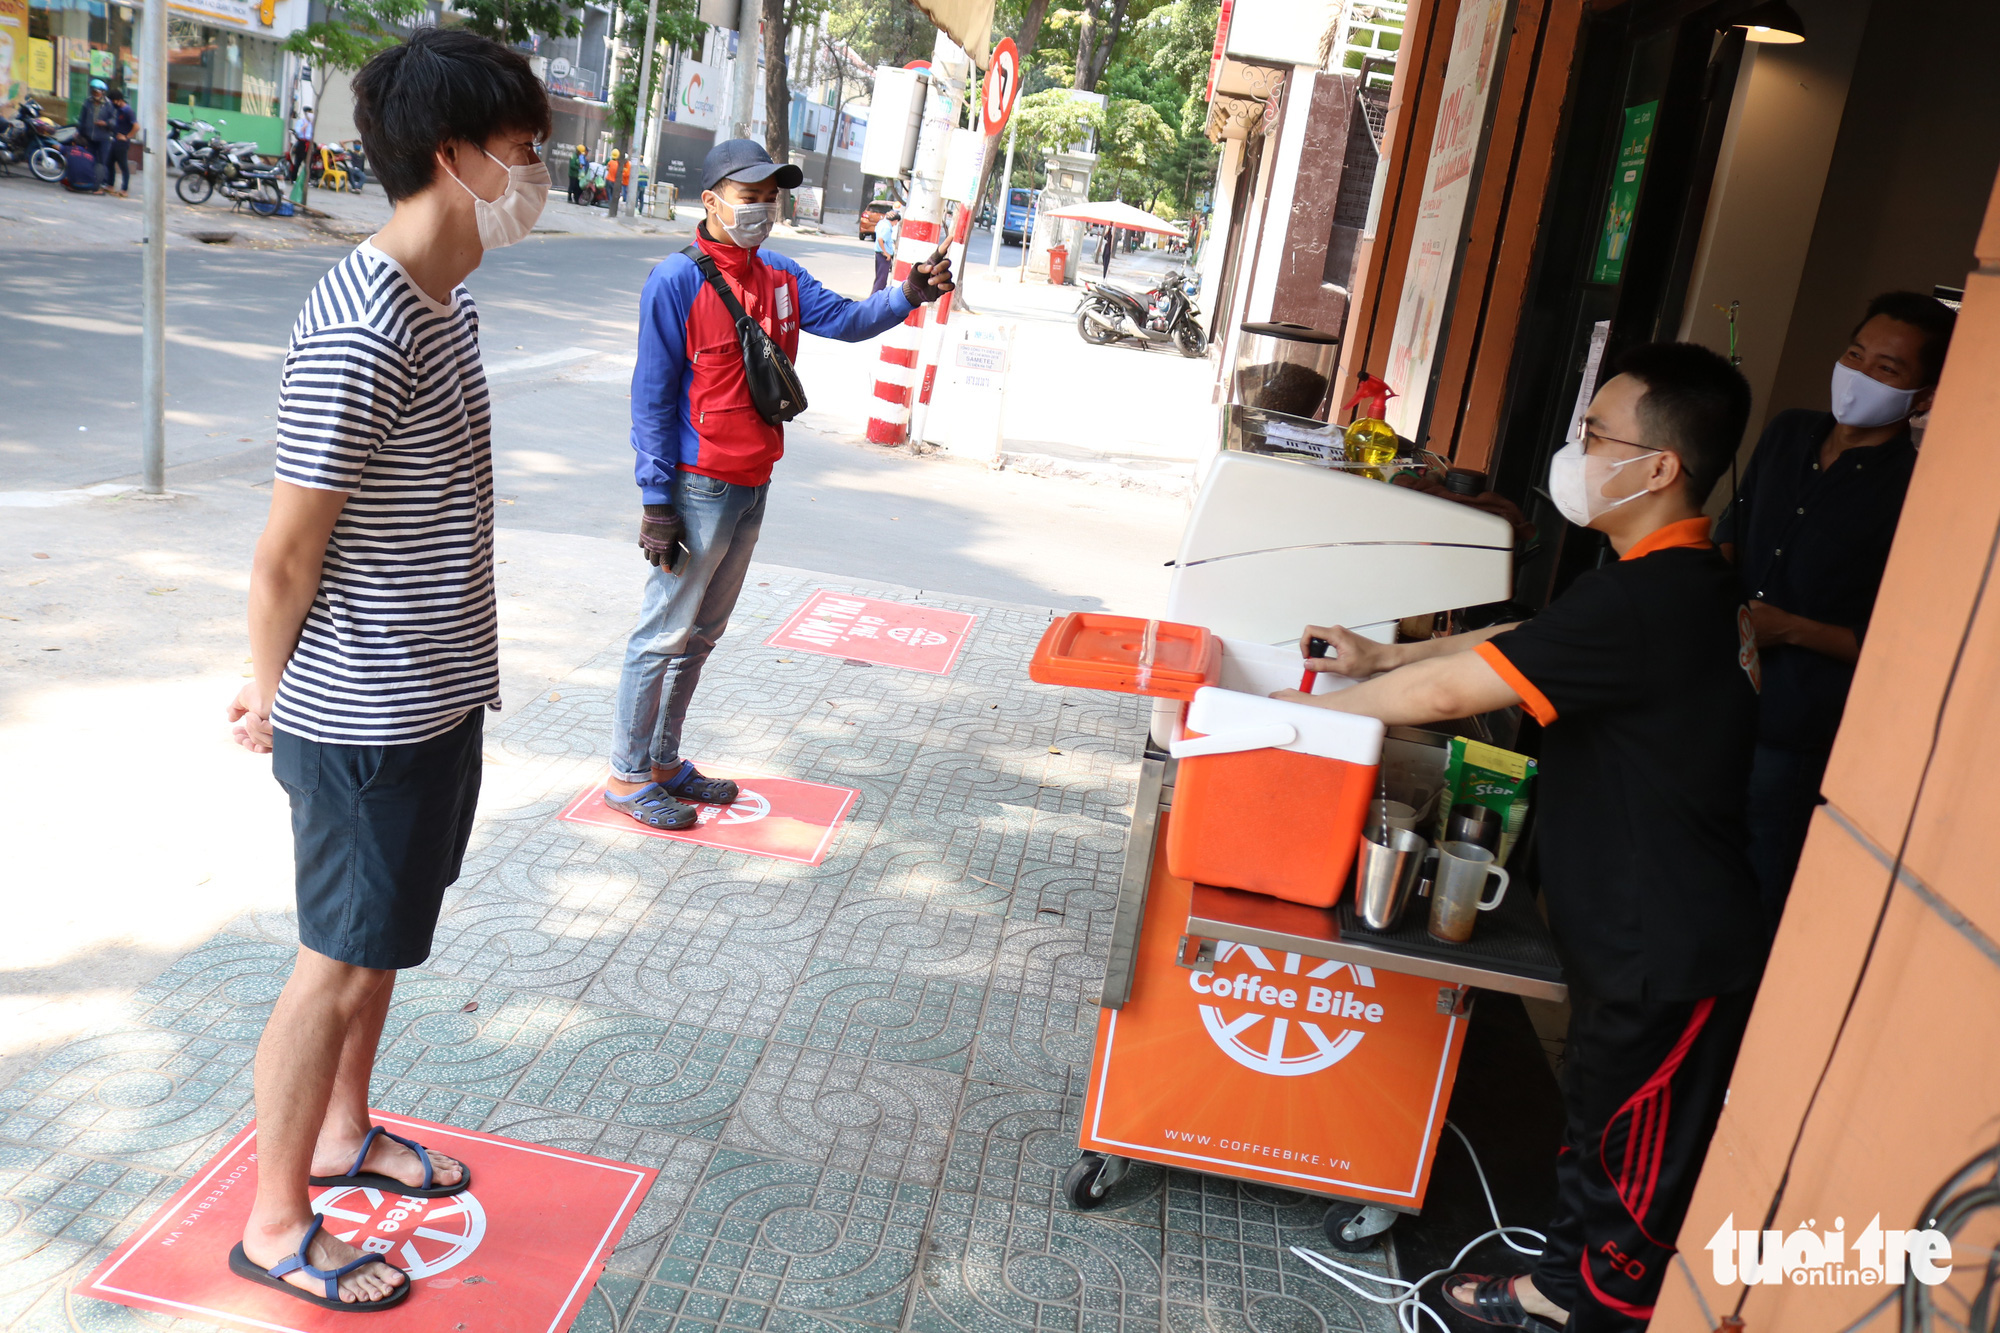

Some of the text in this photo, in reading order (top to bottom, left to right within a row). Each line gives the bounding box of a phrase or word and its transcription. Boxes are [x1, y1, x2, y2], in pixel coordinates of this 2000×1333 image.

[789, 597, 867, 647] PHA MÁY
[1475, 784, 1514, 795] Star
[1189, 970, 1384, 1023] Coffee Bike
[1165, 1129, 1350, 1170] WWW.COFFEEBIKE.VN
[161, 1153, 259, 1246] W.COFFEEBIKE.VN
[377, 1195, 429, 1232] ffee
